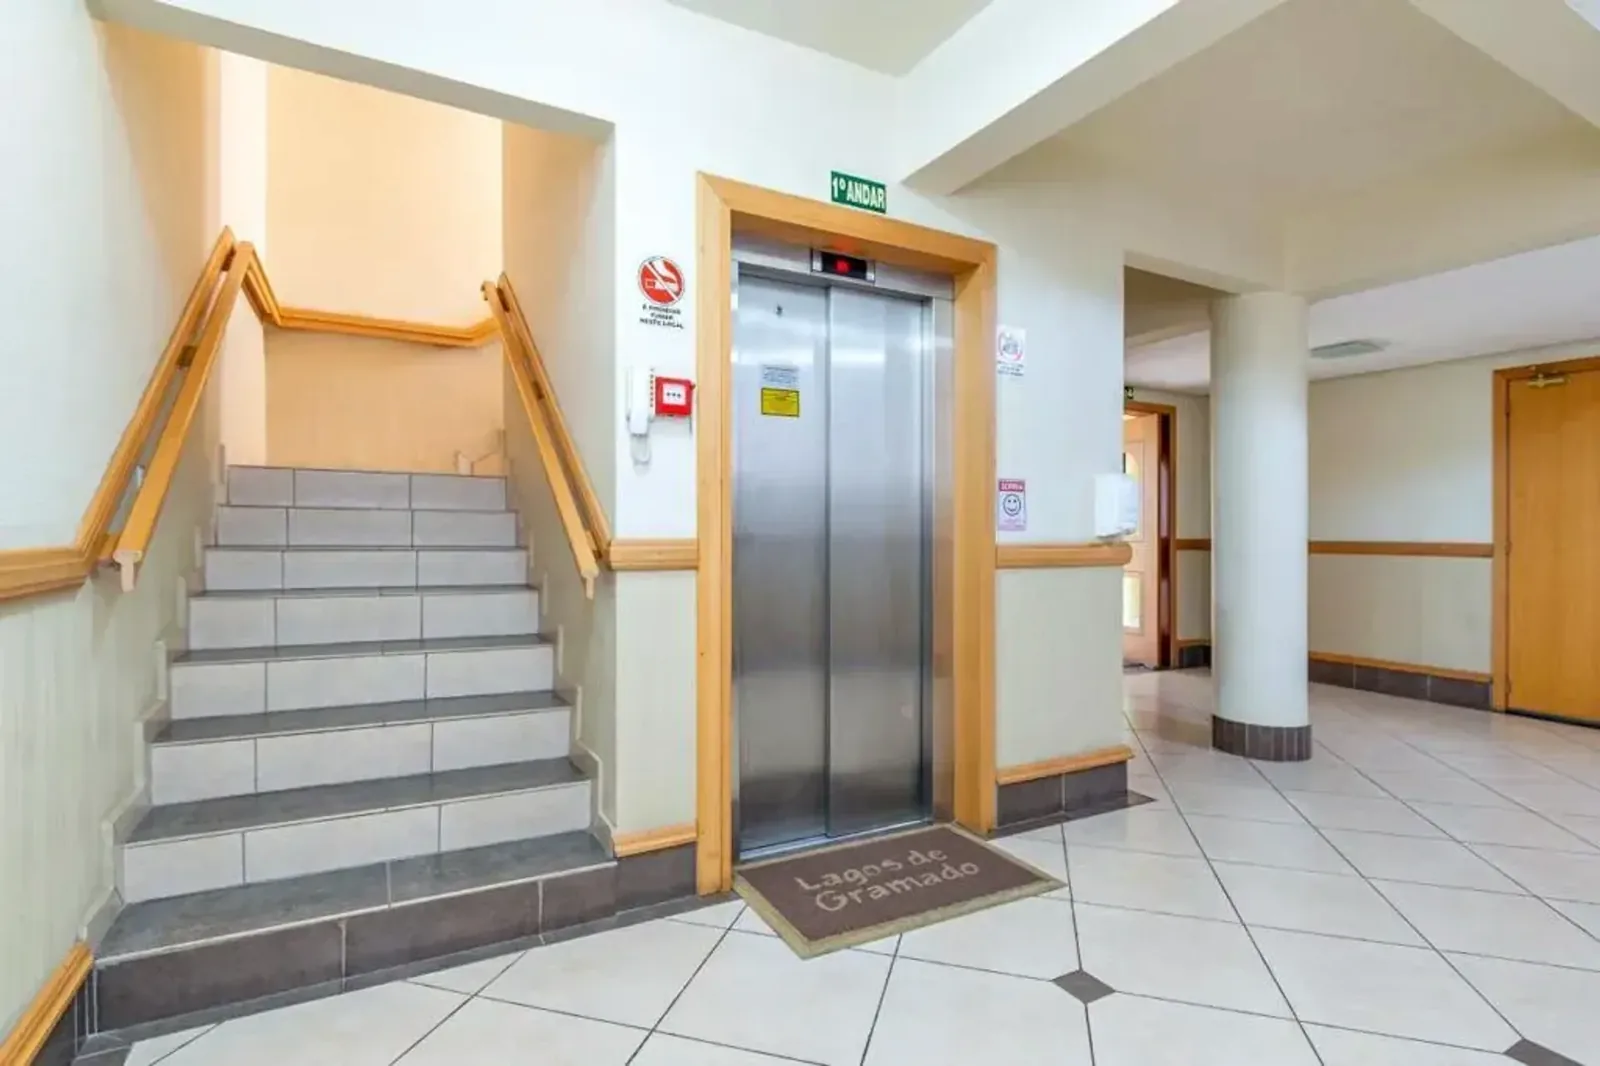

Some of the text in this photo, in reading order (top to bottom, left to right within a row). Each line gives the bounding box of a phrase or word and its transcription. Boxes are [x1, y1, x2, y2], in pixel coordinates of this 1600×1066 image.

[846, 180, 885, 208] ANDAR
[794, 849, 948, 890] Lagos de
[815, 862, 980, 911] Gramado
